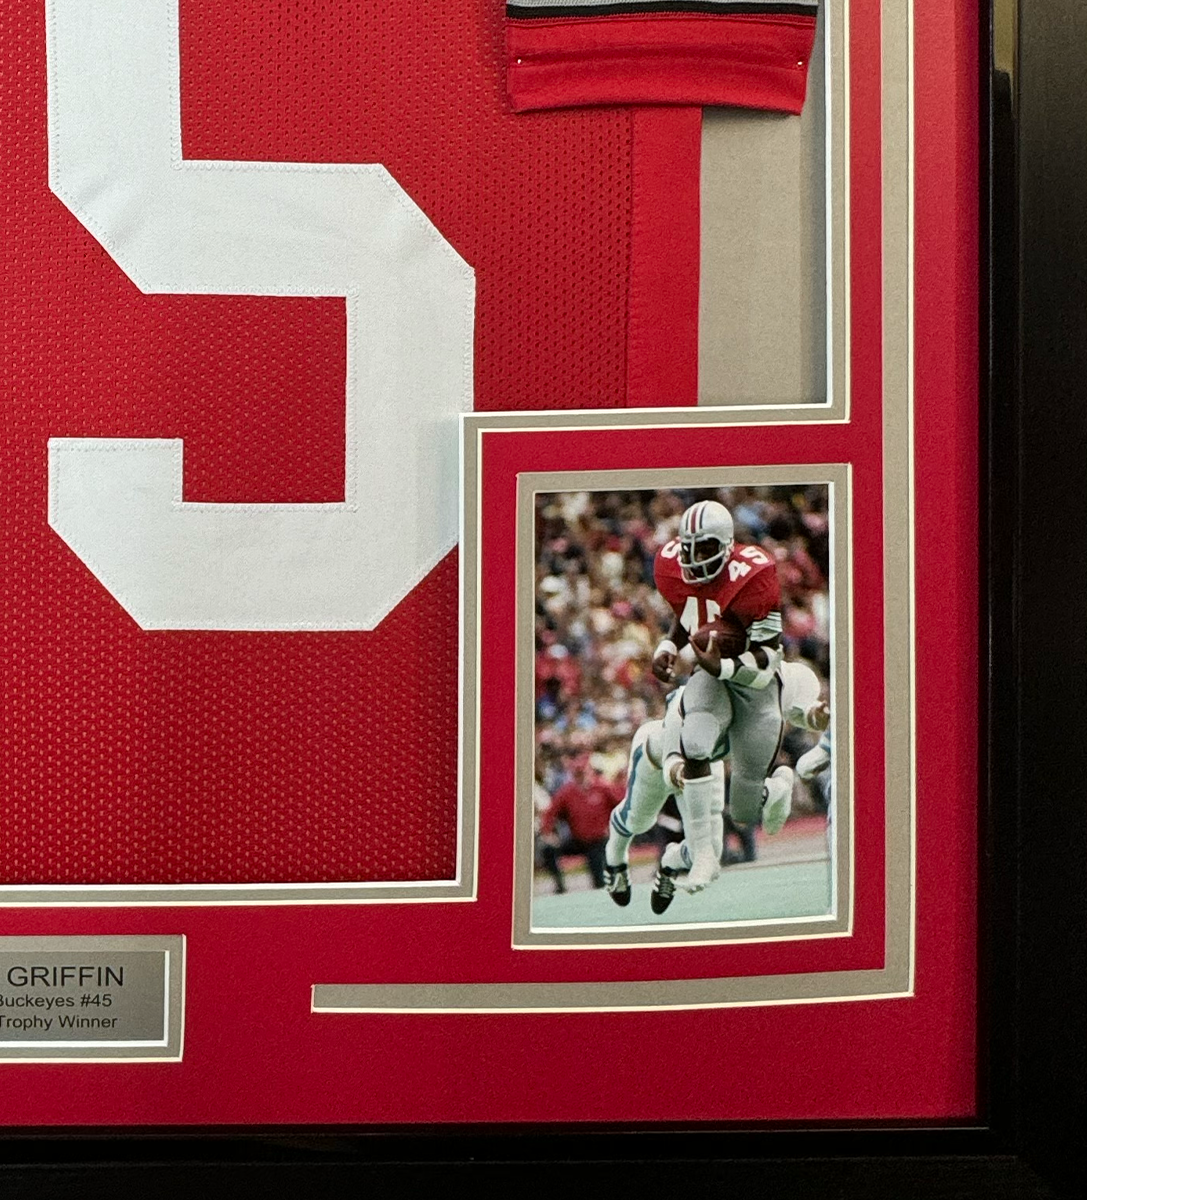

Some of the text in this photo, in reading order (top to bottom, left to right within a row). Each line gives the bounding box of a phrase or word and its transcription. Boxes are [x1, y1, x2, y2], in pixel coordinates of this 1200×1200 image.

[7, 966, 124, 987] GRIFFIN
[80, 993, 113, 1008] #45
[58, 1014, 118, 1029] Winner
